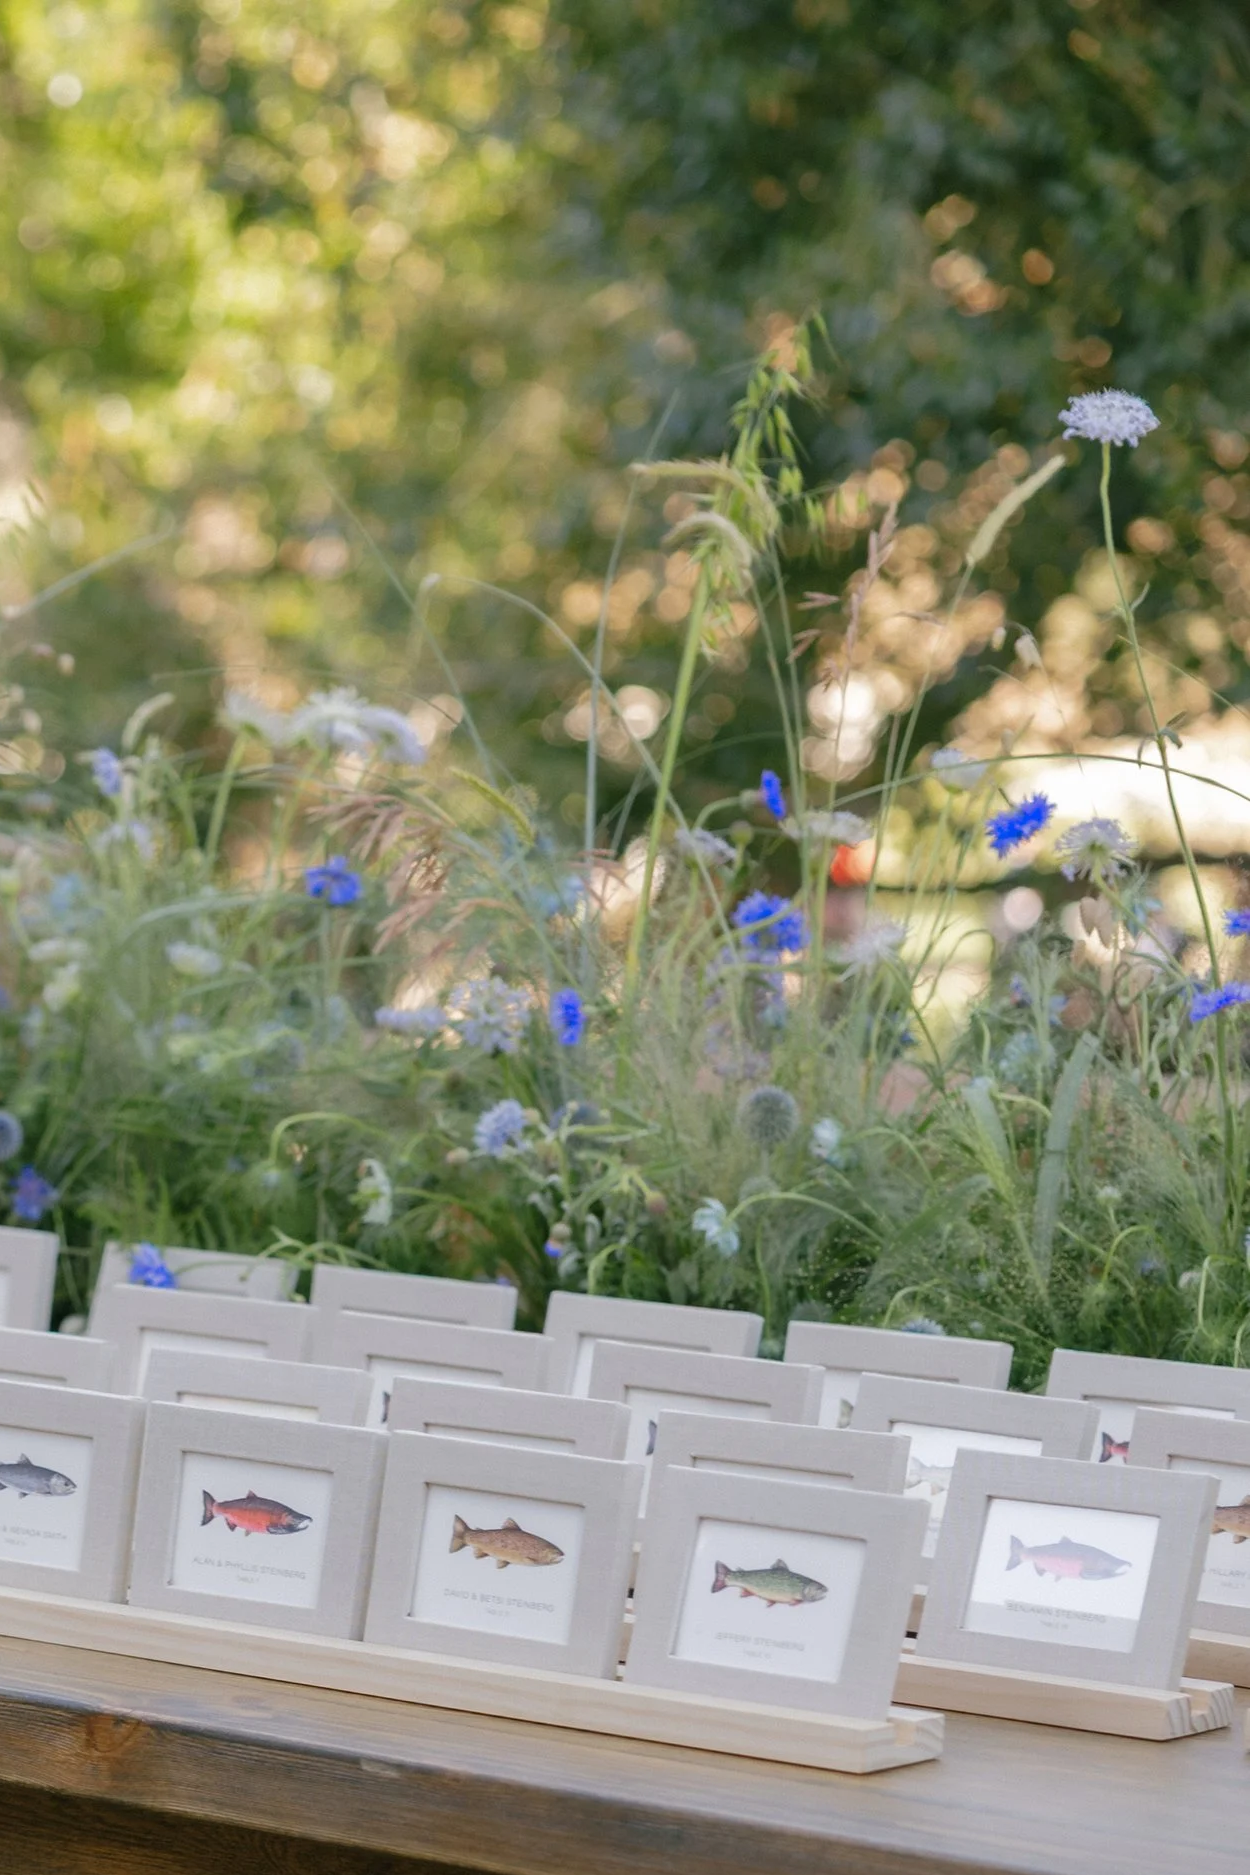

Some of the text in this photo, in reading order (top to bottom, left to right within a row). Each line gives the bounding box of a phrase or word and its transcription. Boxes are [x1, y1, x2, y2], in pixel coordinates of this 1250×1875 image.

[191, 1556, 306, 1580] ALAN & PHYLLIS STEINBERG
[443, 1588, 470, 1600] DAVID
[471, 1592, 478, 1601] &
[506, 1597, 555, 1613] STEINBERG
[1005, 1600, 1107, 1624] BENJAMIN STEINBERG
[753, 1636, 805, 1652] STEINBERG
